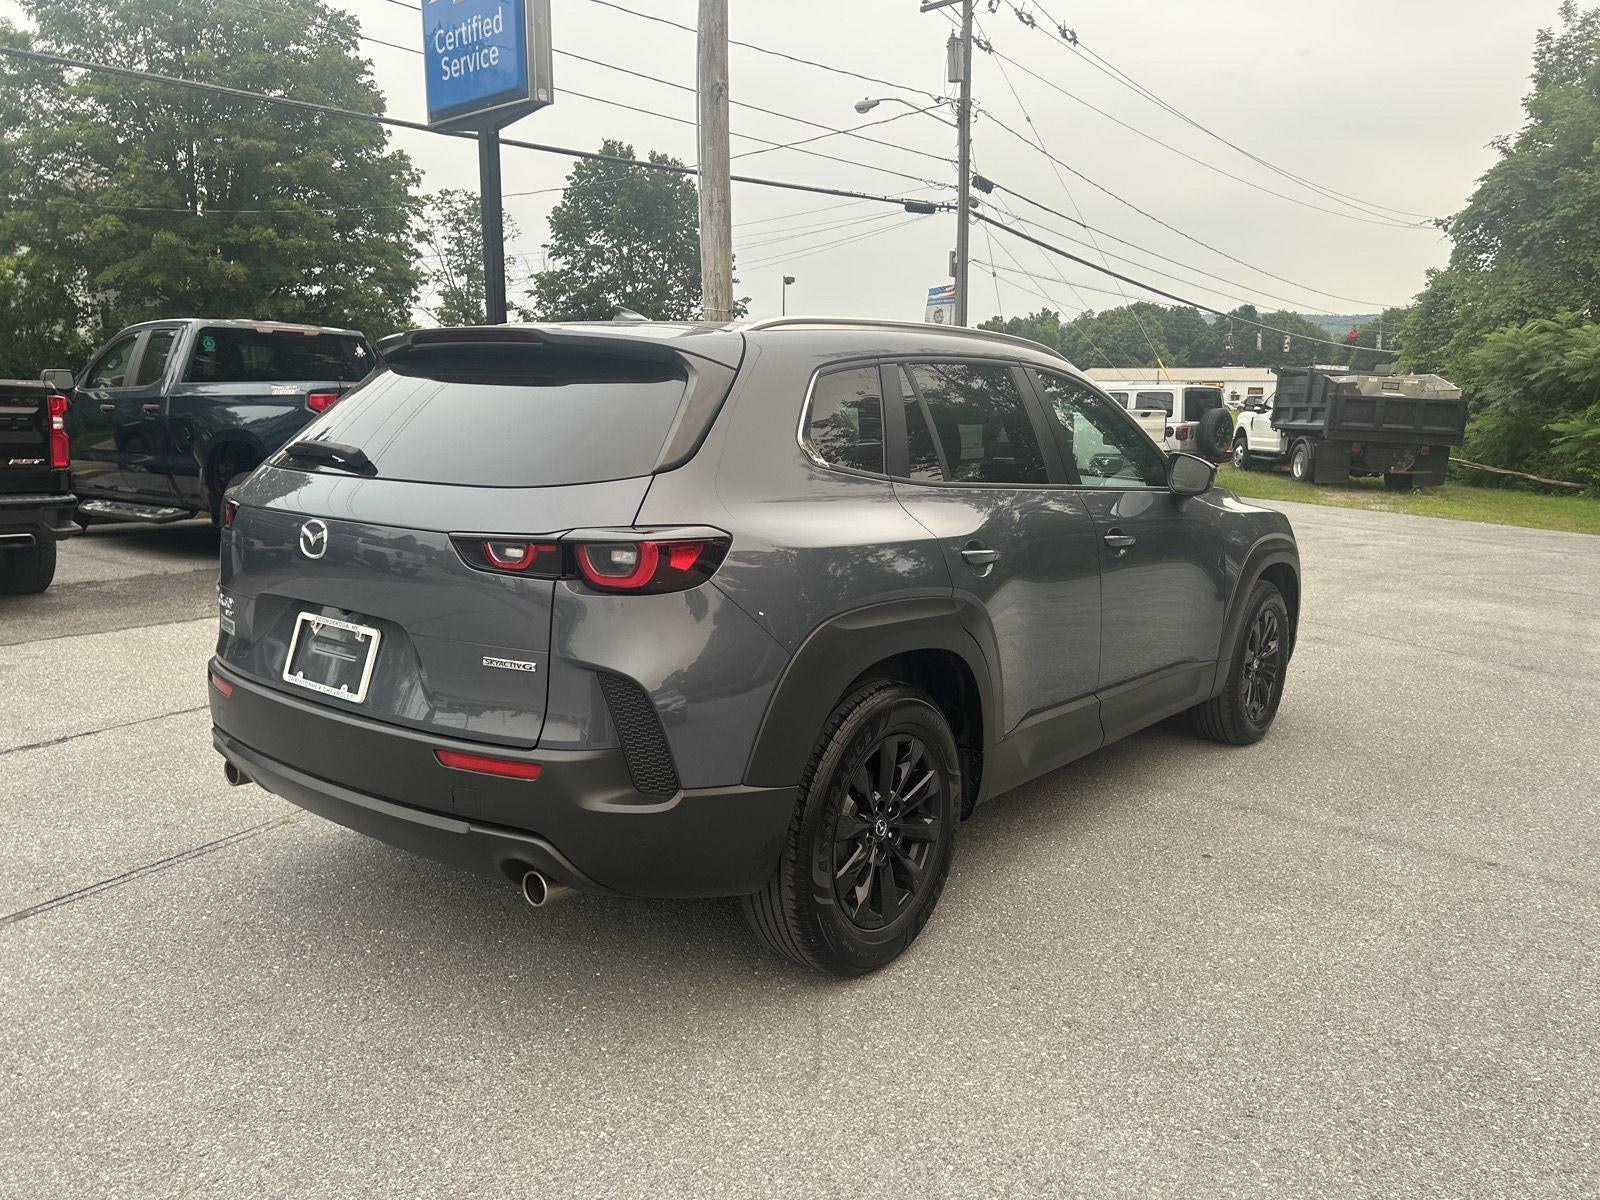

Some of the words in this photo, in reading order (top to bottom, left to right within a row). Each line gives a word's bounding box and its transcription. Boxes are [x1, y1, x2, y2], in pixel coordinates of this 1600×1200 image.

[435, 6, 503, 54] Certified
[441, 46, 499, 81] Service
[322, 686, 353, 699] CHEVROLET
